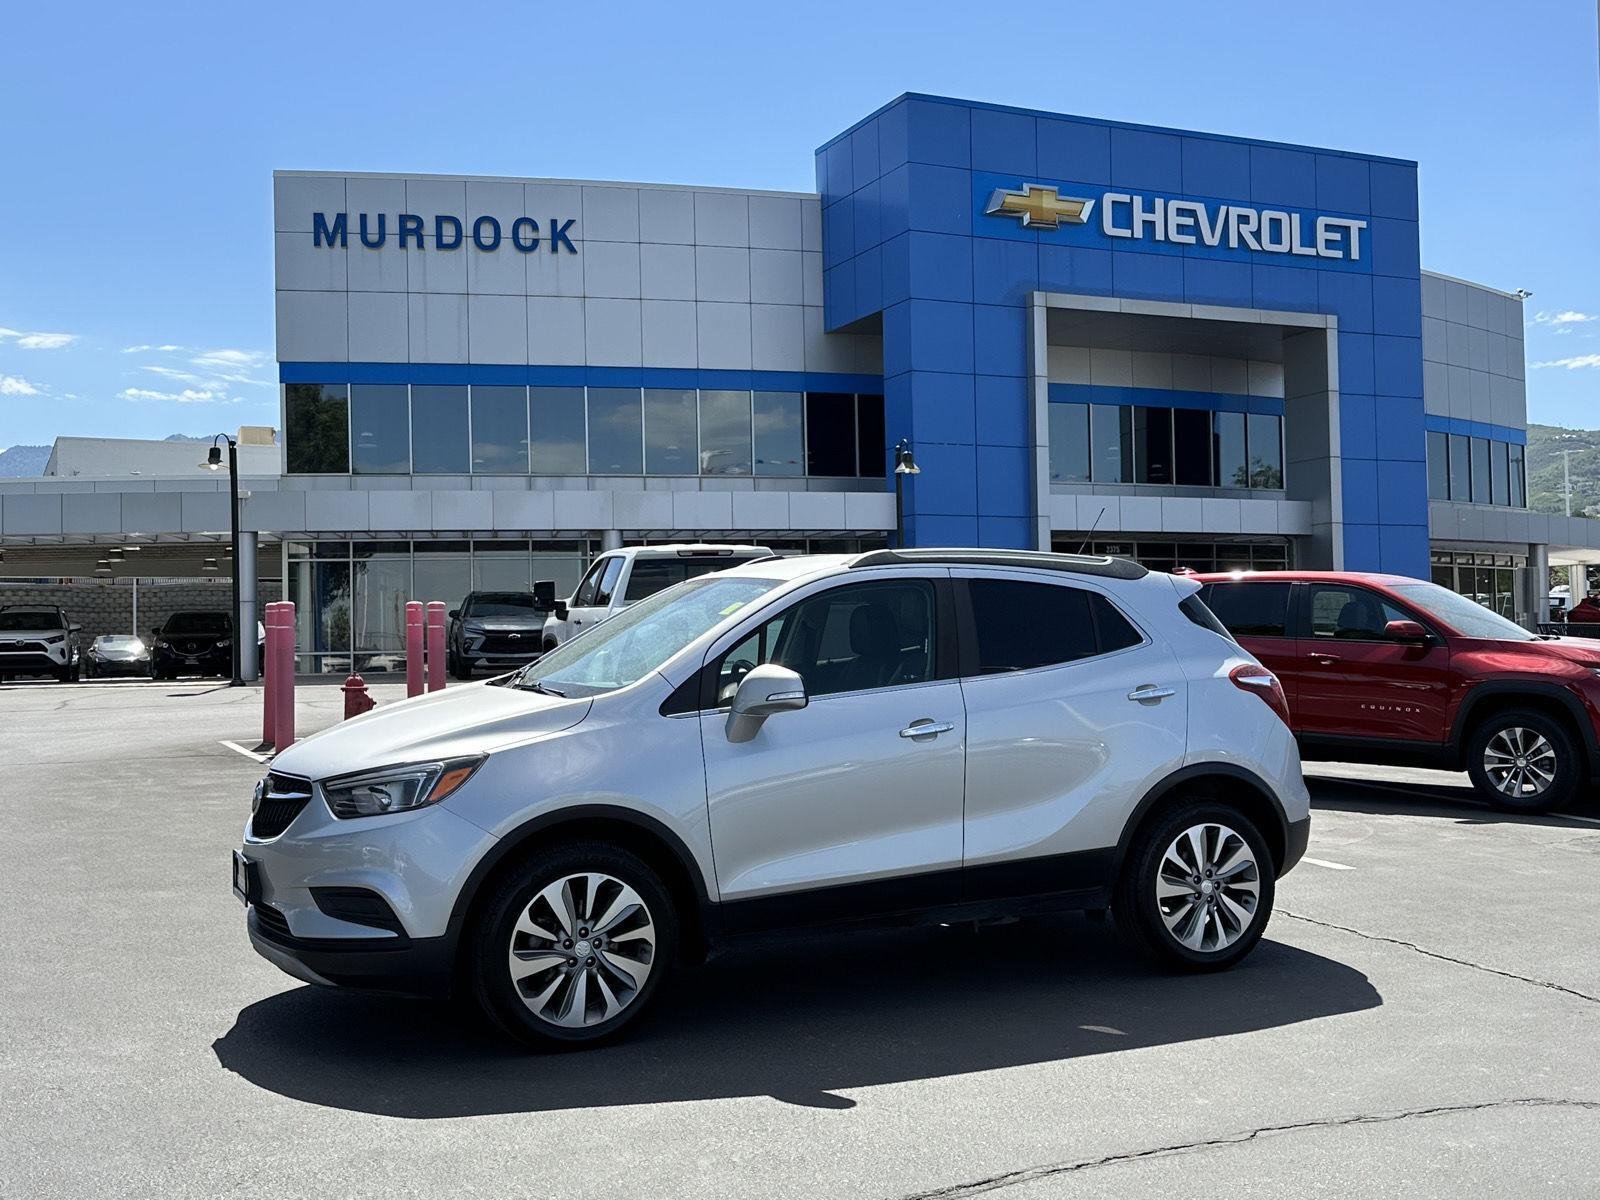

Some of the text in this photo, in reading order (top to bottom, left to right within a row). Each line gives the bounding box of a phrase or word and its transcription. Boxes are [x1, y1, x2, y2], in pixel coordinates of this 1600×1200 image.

[313, 212, 578, 254] MURDOCK
[1102, 192, 1367, 260] CHEVROLET
[1360, 703, 1421, 713] EQUINOX
